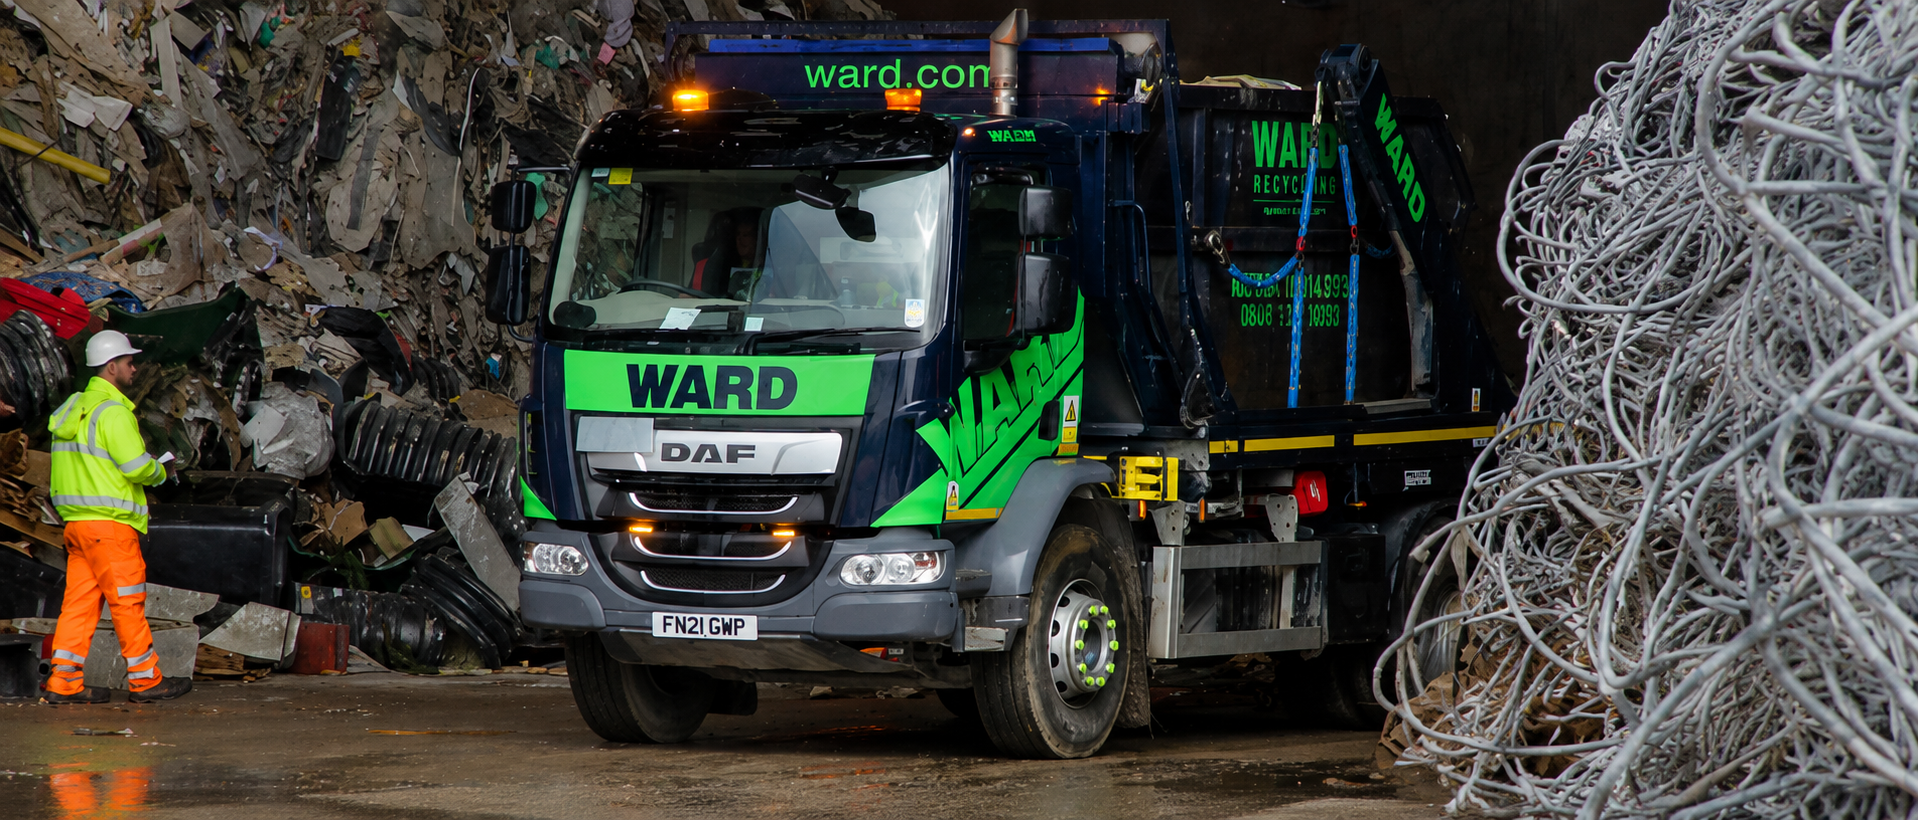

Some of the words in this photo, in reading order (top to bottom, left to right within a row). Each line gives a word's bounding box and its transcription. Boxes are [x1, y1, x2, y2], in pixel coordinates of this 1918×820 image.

[1374, 92, 1426, 222] WARD
[626, 363, 798, 410] WARD
[660, 442, 756, 464] DAF
[662, 615, 704, 635] FN21
[708, 617, 746, 636] GWP
